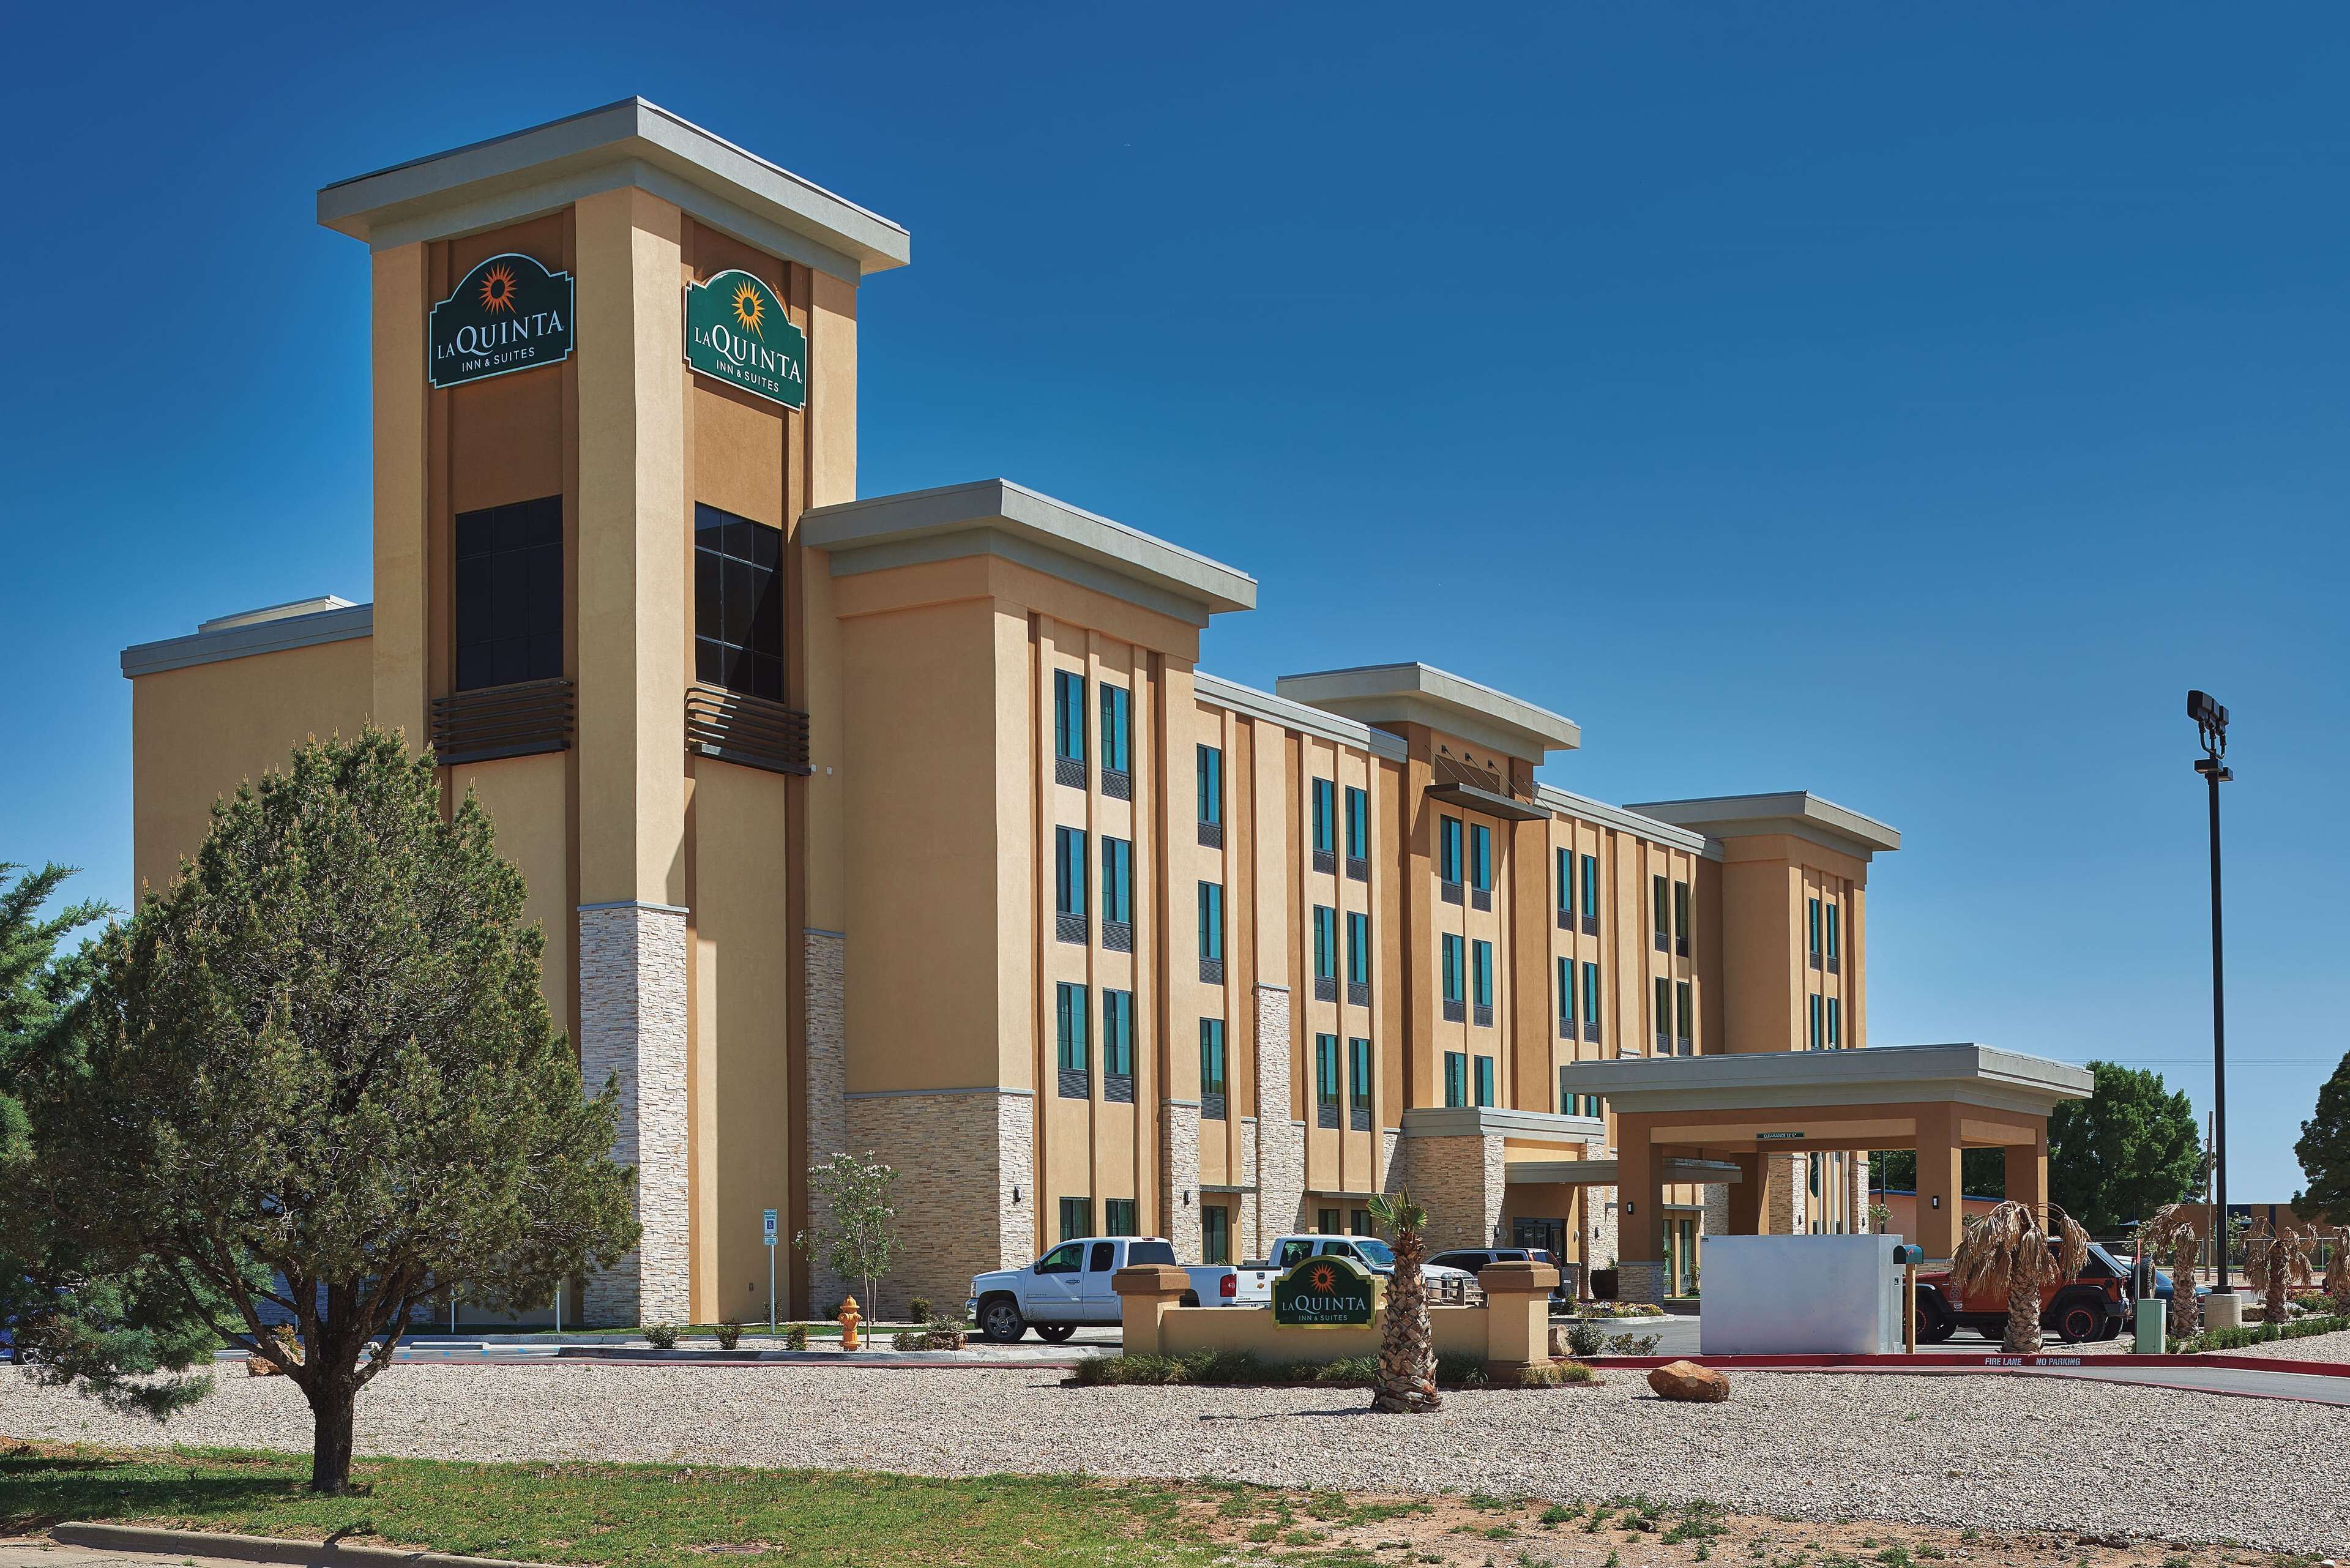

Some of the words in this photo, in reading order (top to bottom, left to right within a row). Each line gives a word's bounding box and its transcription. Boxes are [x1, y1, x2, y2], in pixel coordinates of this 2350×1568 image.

[438, 343, 455, 359] LA
[457, 310, 564, 356] QUINTA
[462, 359, 481, 372] INN
[494, 347, 535, 364] SUITES
[695, 327, 711, 348] LA
[712, 324, 802, 384] QUINTA
[717, 359, 734, 375] INN
[736, 370, 742, 378] &
[744, 371, 779, 392] SUITES
[1283, 1302, 1294, 1311] LA
[1295, 1295, 1367, 1314] QUINTA
